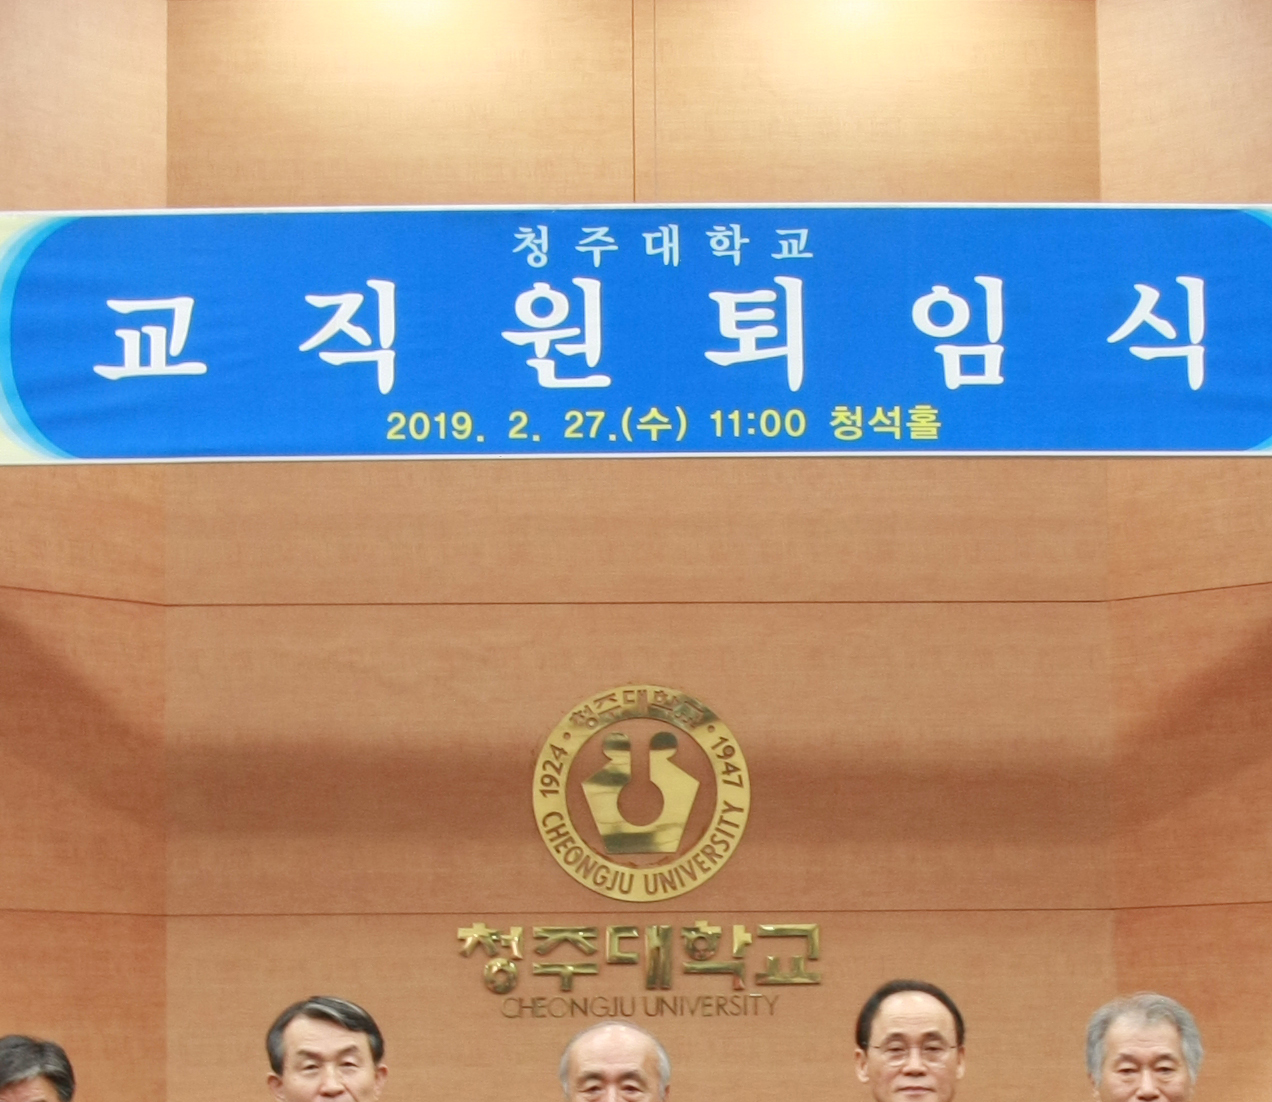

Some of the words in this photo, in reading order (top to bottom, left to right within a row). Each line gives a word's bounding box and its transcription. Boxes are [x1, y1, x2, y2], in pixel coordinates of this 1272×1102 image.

[512, 222, 815, 269] 청주대학교
[385, 410, 486, 443] 2019.
[507, 409, 541, 443] 2.
[563, 405, 688, 443] 27.(수)
[709, 408, 807, 439] 11:00
[829, 403, 943, 442] 청석홀
[569, 688, 708, 729] 청주대학교
[539, 744, 569, 799] 1924
[710, 735, 744, 790] 1947
[540, 809, 634, 895] CHEONGJU
[643, 799, 745, 896] UNIVERSITY
[456, 919, 821, 995] 청주대학교
[500, 996, 635, 1018] CHEONGJU
[643, 993, 780, 1018] UNIVERSITY
